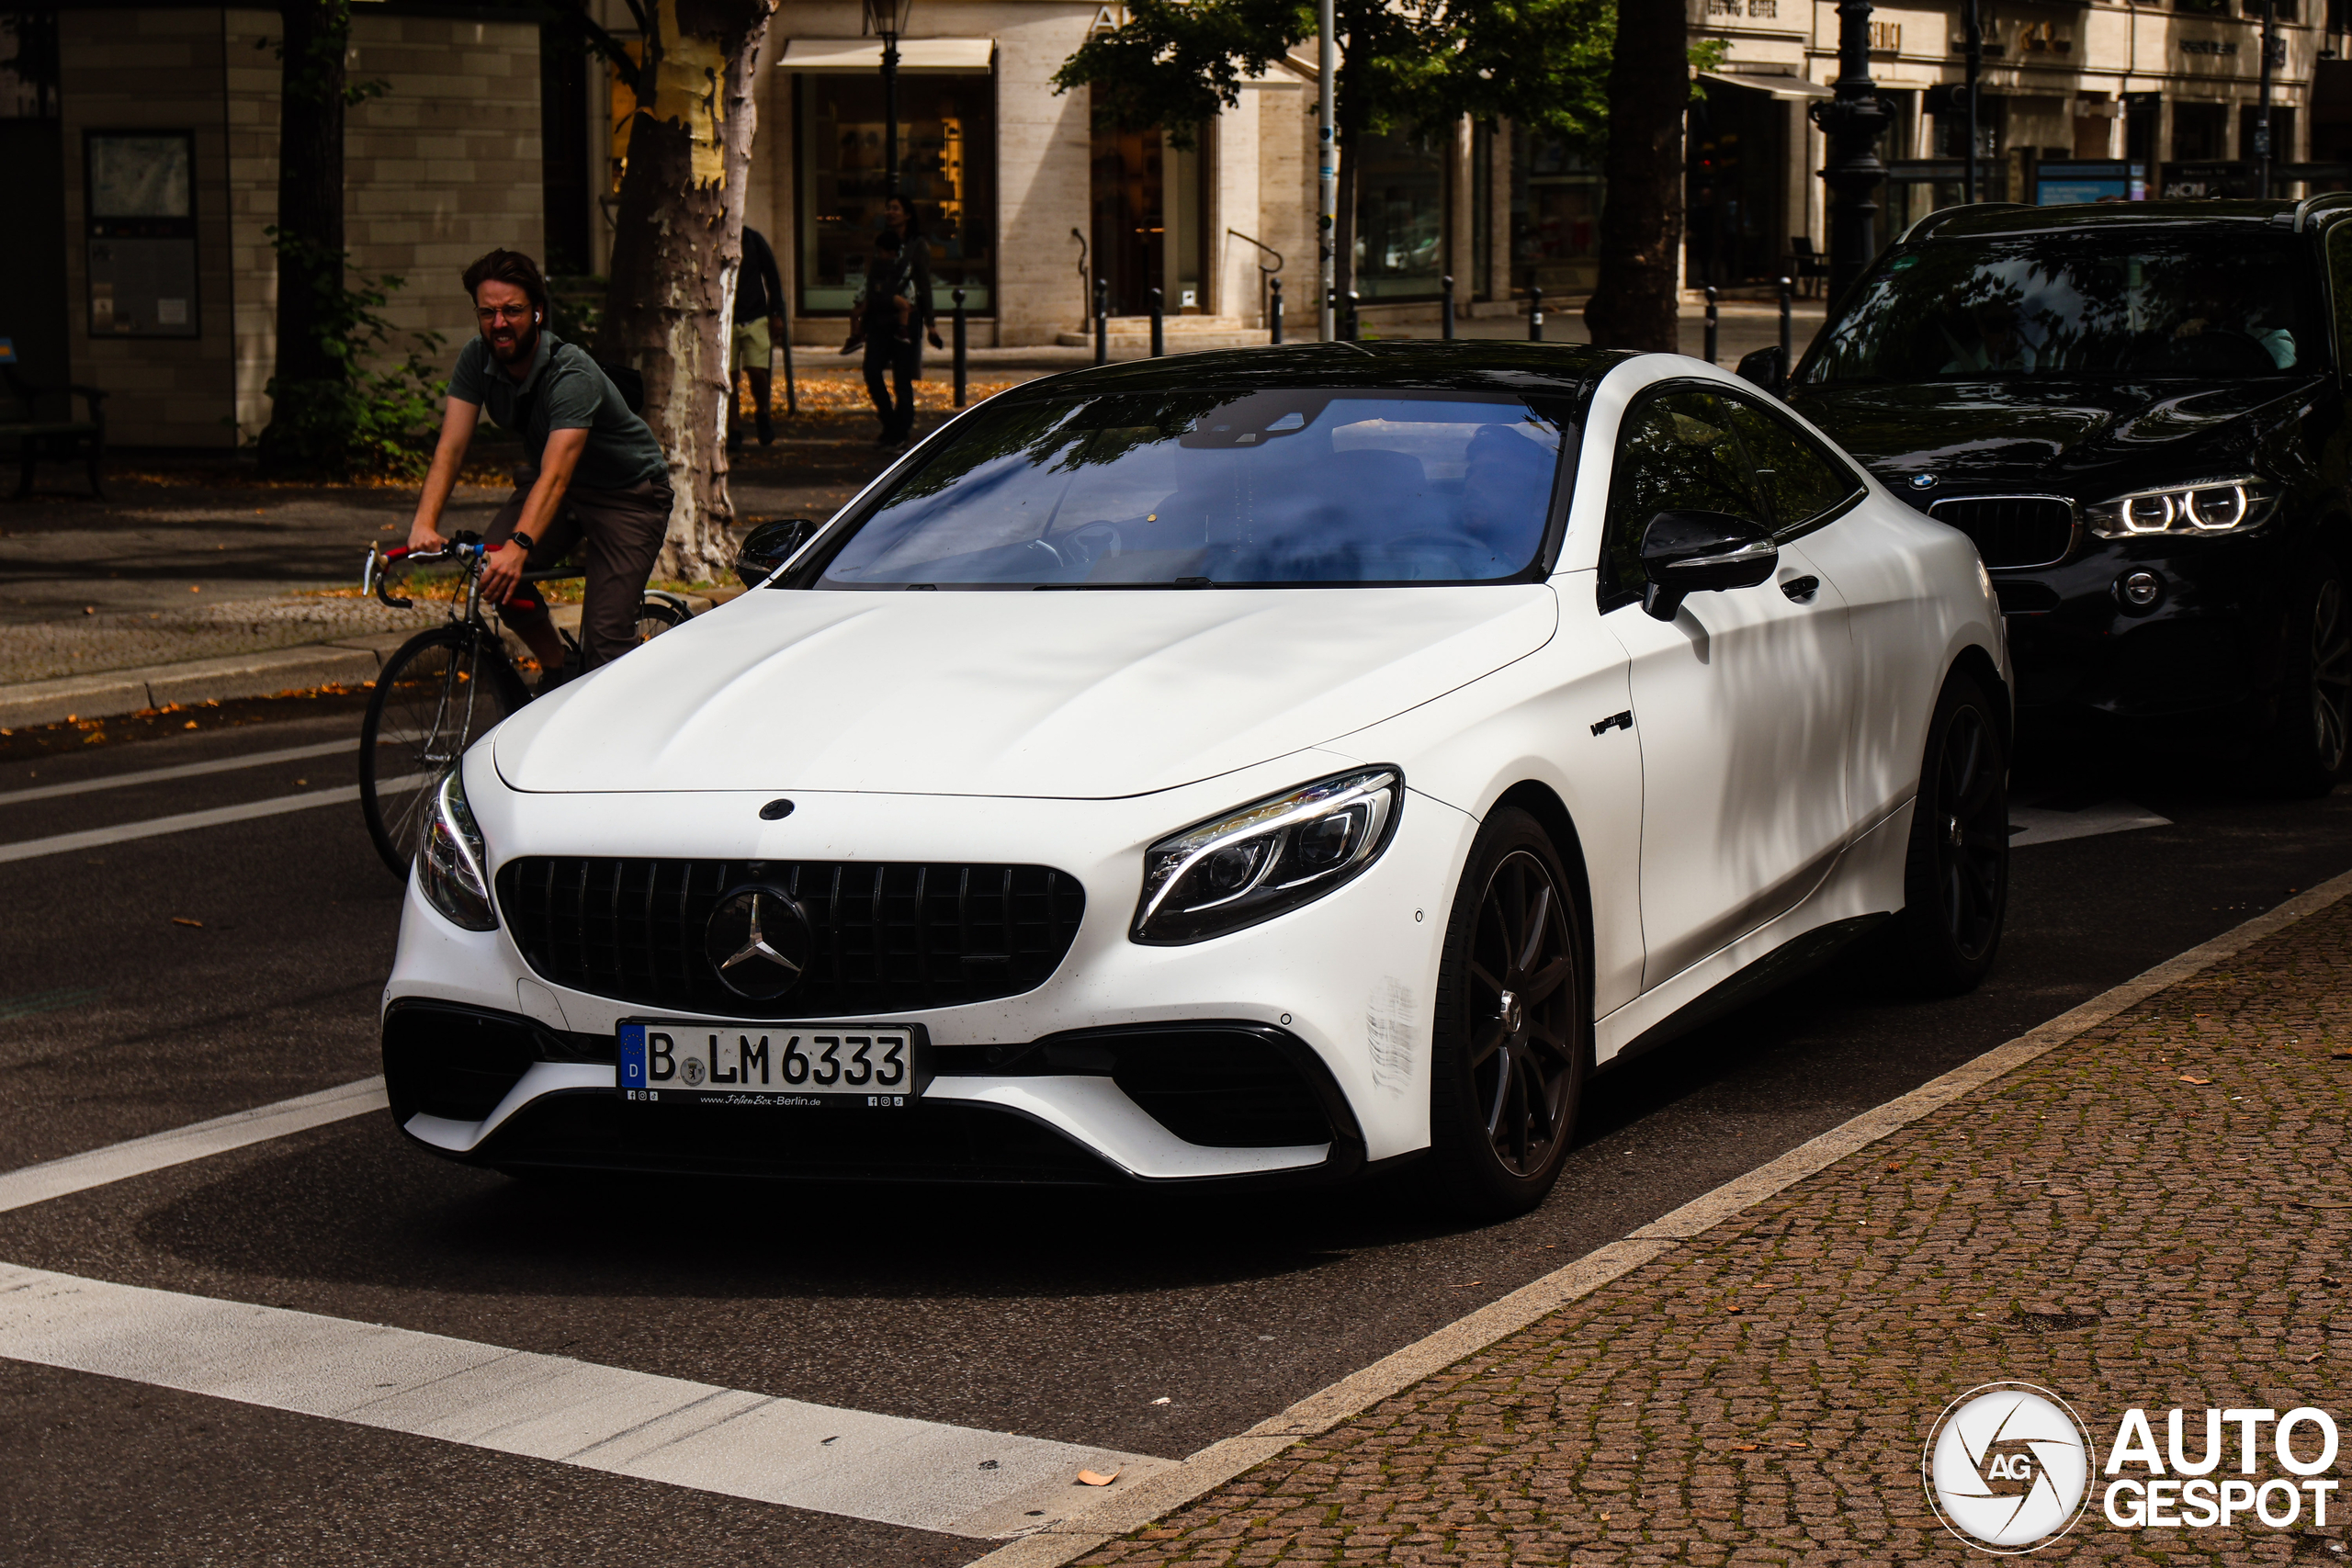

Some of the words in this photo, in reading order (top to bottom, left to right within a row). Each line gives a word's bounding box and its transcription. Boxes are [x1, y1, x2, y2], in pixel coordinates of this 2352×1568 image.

[628, 1064, 639, 1077] D
[649, 1032, 676, 1081] B
[708, 1034, 769, 1084] LM
[782, 1036, 904, 1086] 6333
